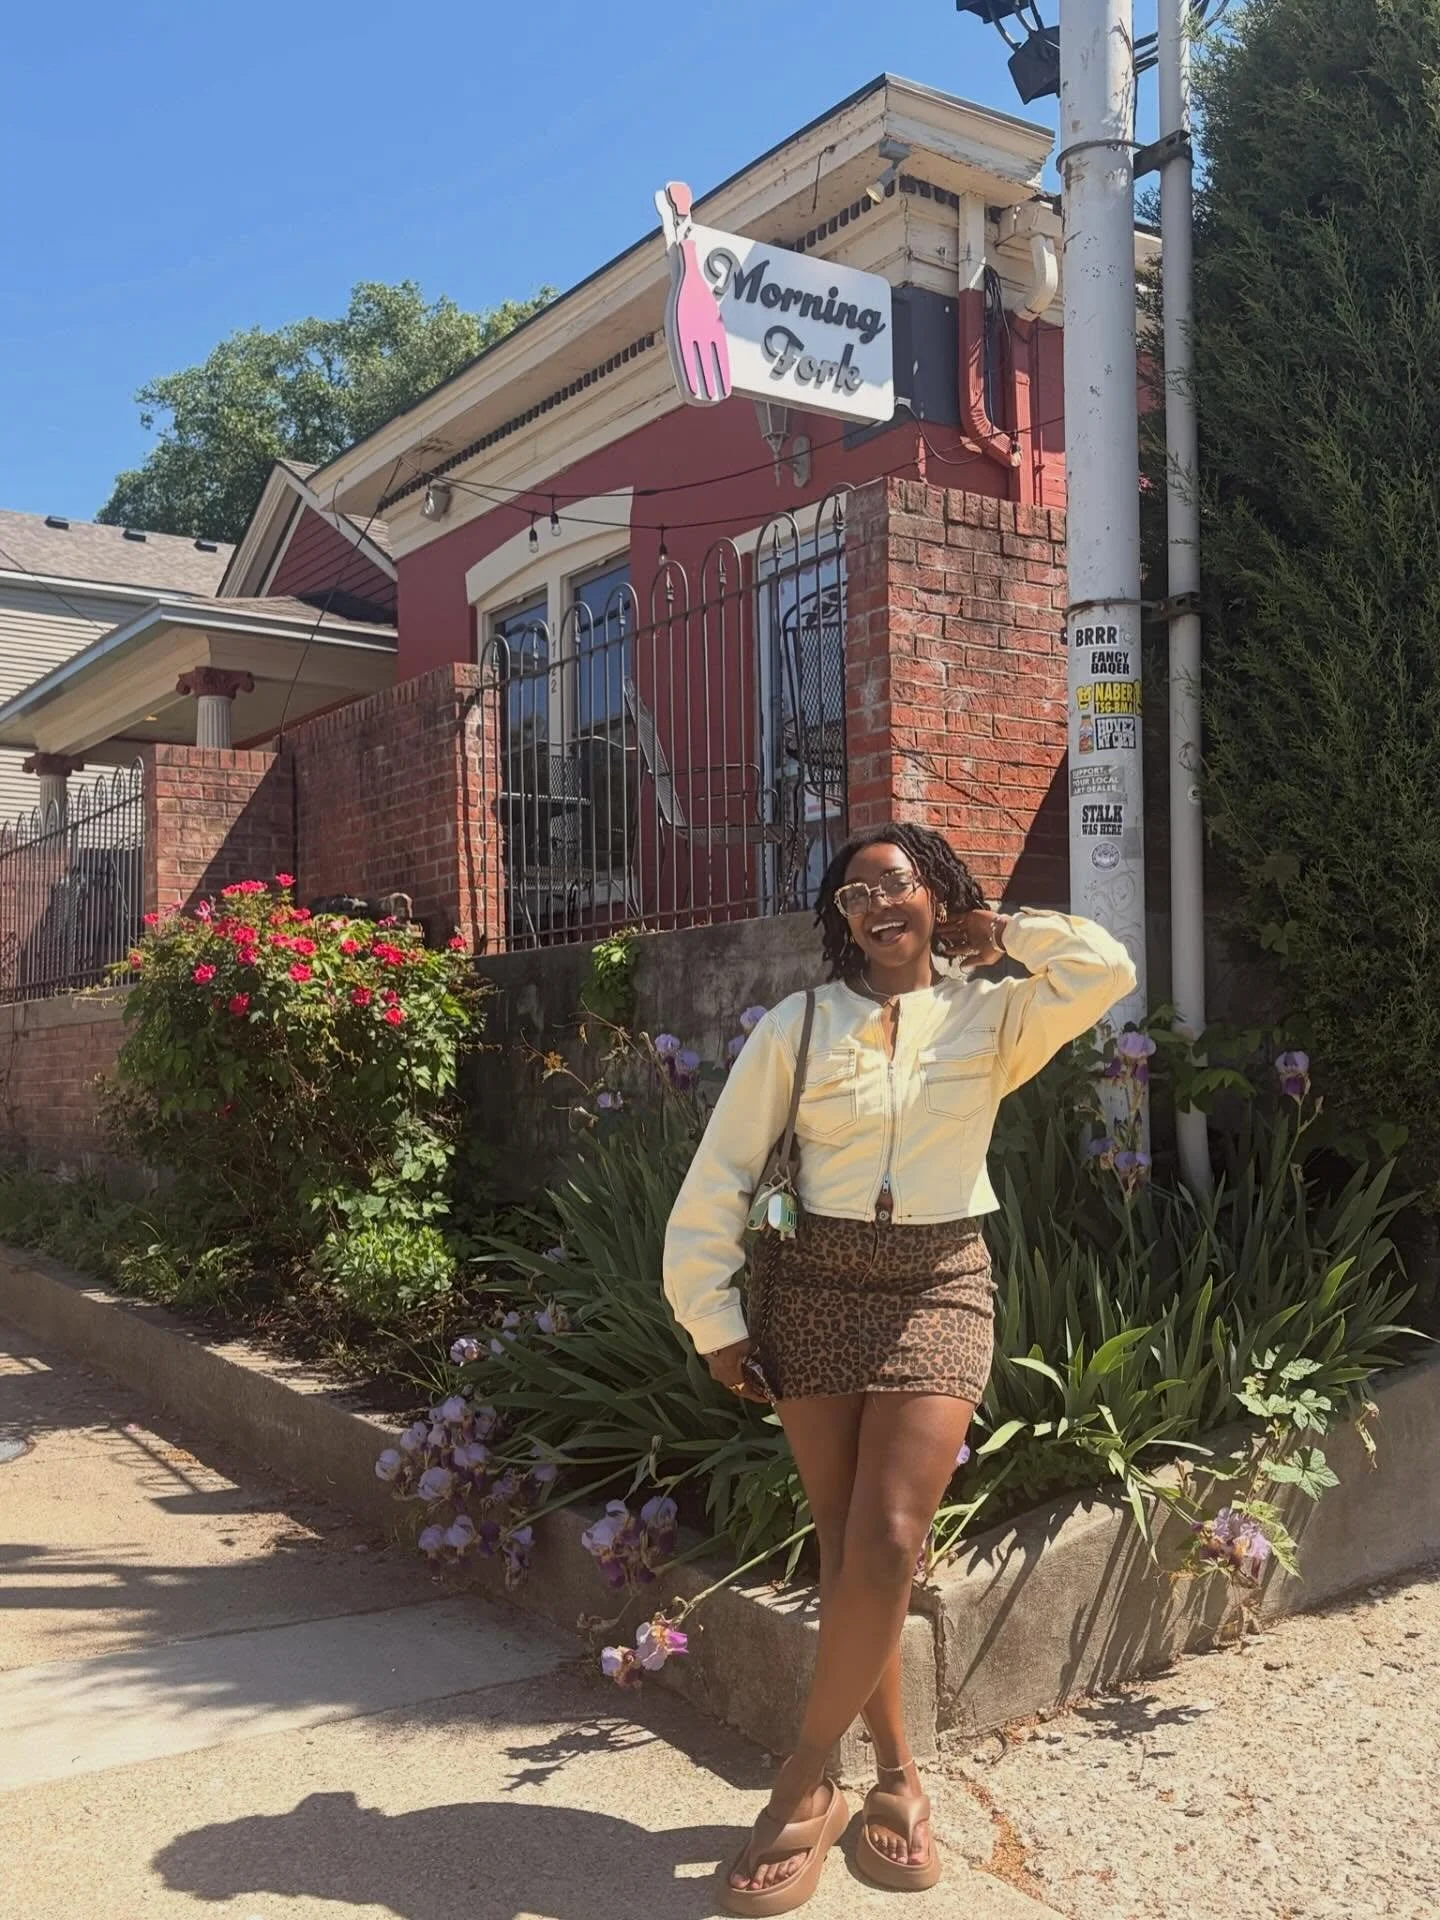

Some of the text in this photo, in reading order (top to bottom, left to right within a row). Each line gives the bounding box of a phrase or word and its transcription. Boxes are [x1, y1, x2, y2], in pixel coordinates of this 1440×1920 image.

[704, 247, 886, 344] Morning
[761, 325, 863, 396] Fork
[1075, 626, 1118, 648] BRRR
[1091, 651, 1129, 663] FANCY
[1091, 662, 1130, 675] BAQER
[1095, 682, 1133, 702] NABER
[1091, 776, 1120, 785] LOCAL
[1086, 784, 1117, 793] DEALER
[1082, 805, 1122, 823] STALK
[1082, 824, 1122, 836] WAS HERE
